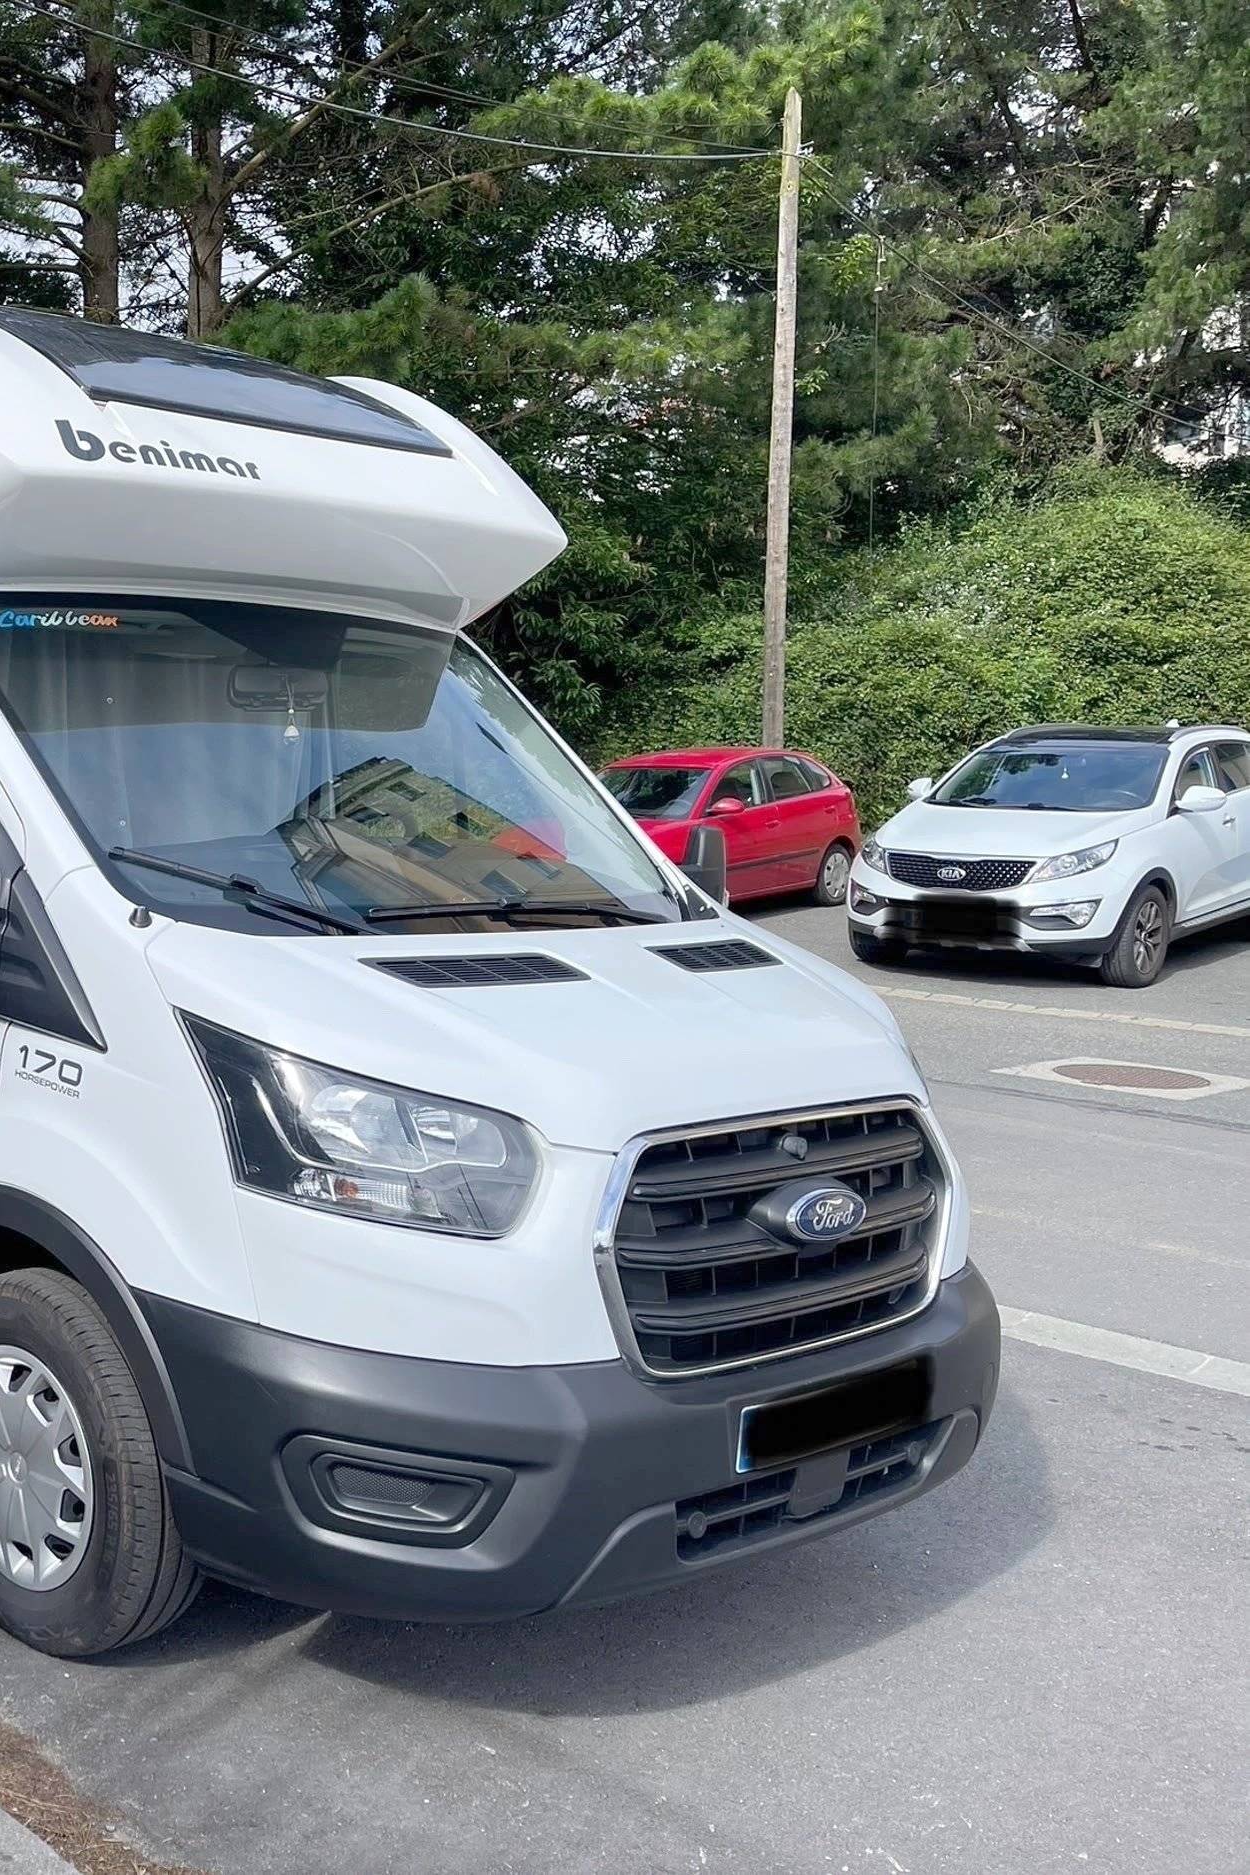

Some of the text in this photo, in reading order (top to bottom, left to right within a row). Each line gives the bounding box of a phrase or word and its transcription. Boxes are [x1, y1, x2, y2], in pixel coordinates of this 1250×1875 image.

[54, 419, 261, 480] benimar
[14, 1069, 80, 1098] HORSEPOWER
[19, 1045, 82, 1086] 170
[813, 1199, 854, 1231] Ford
